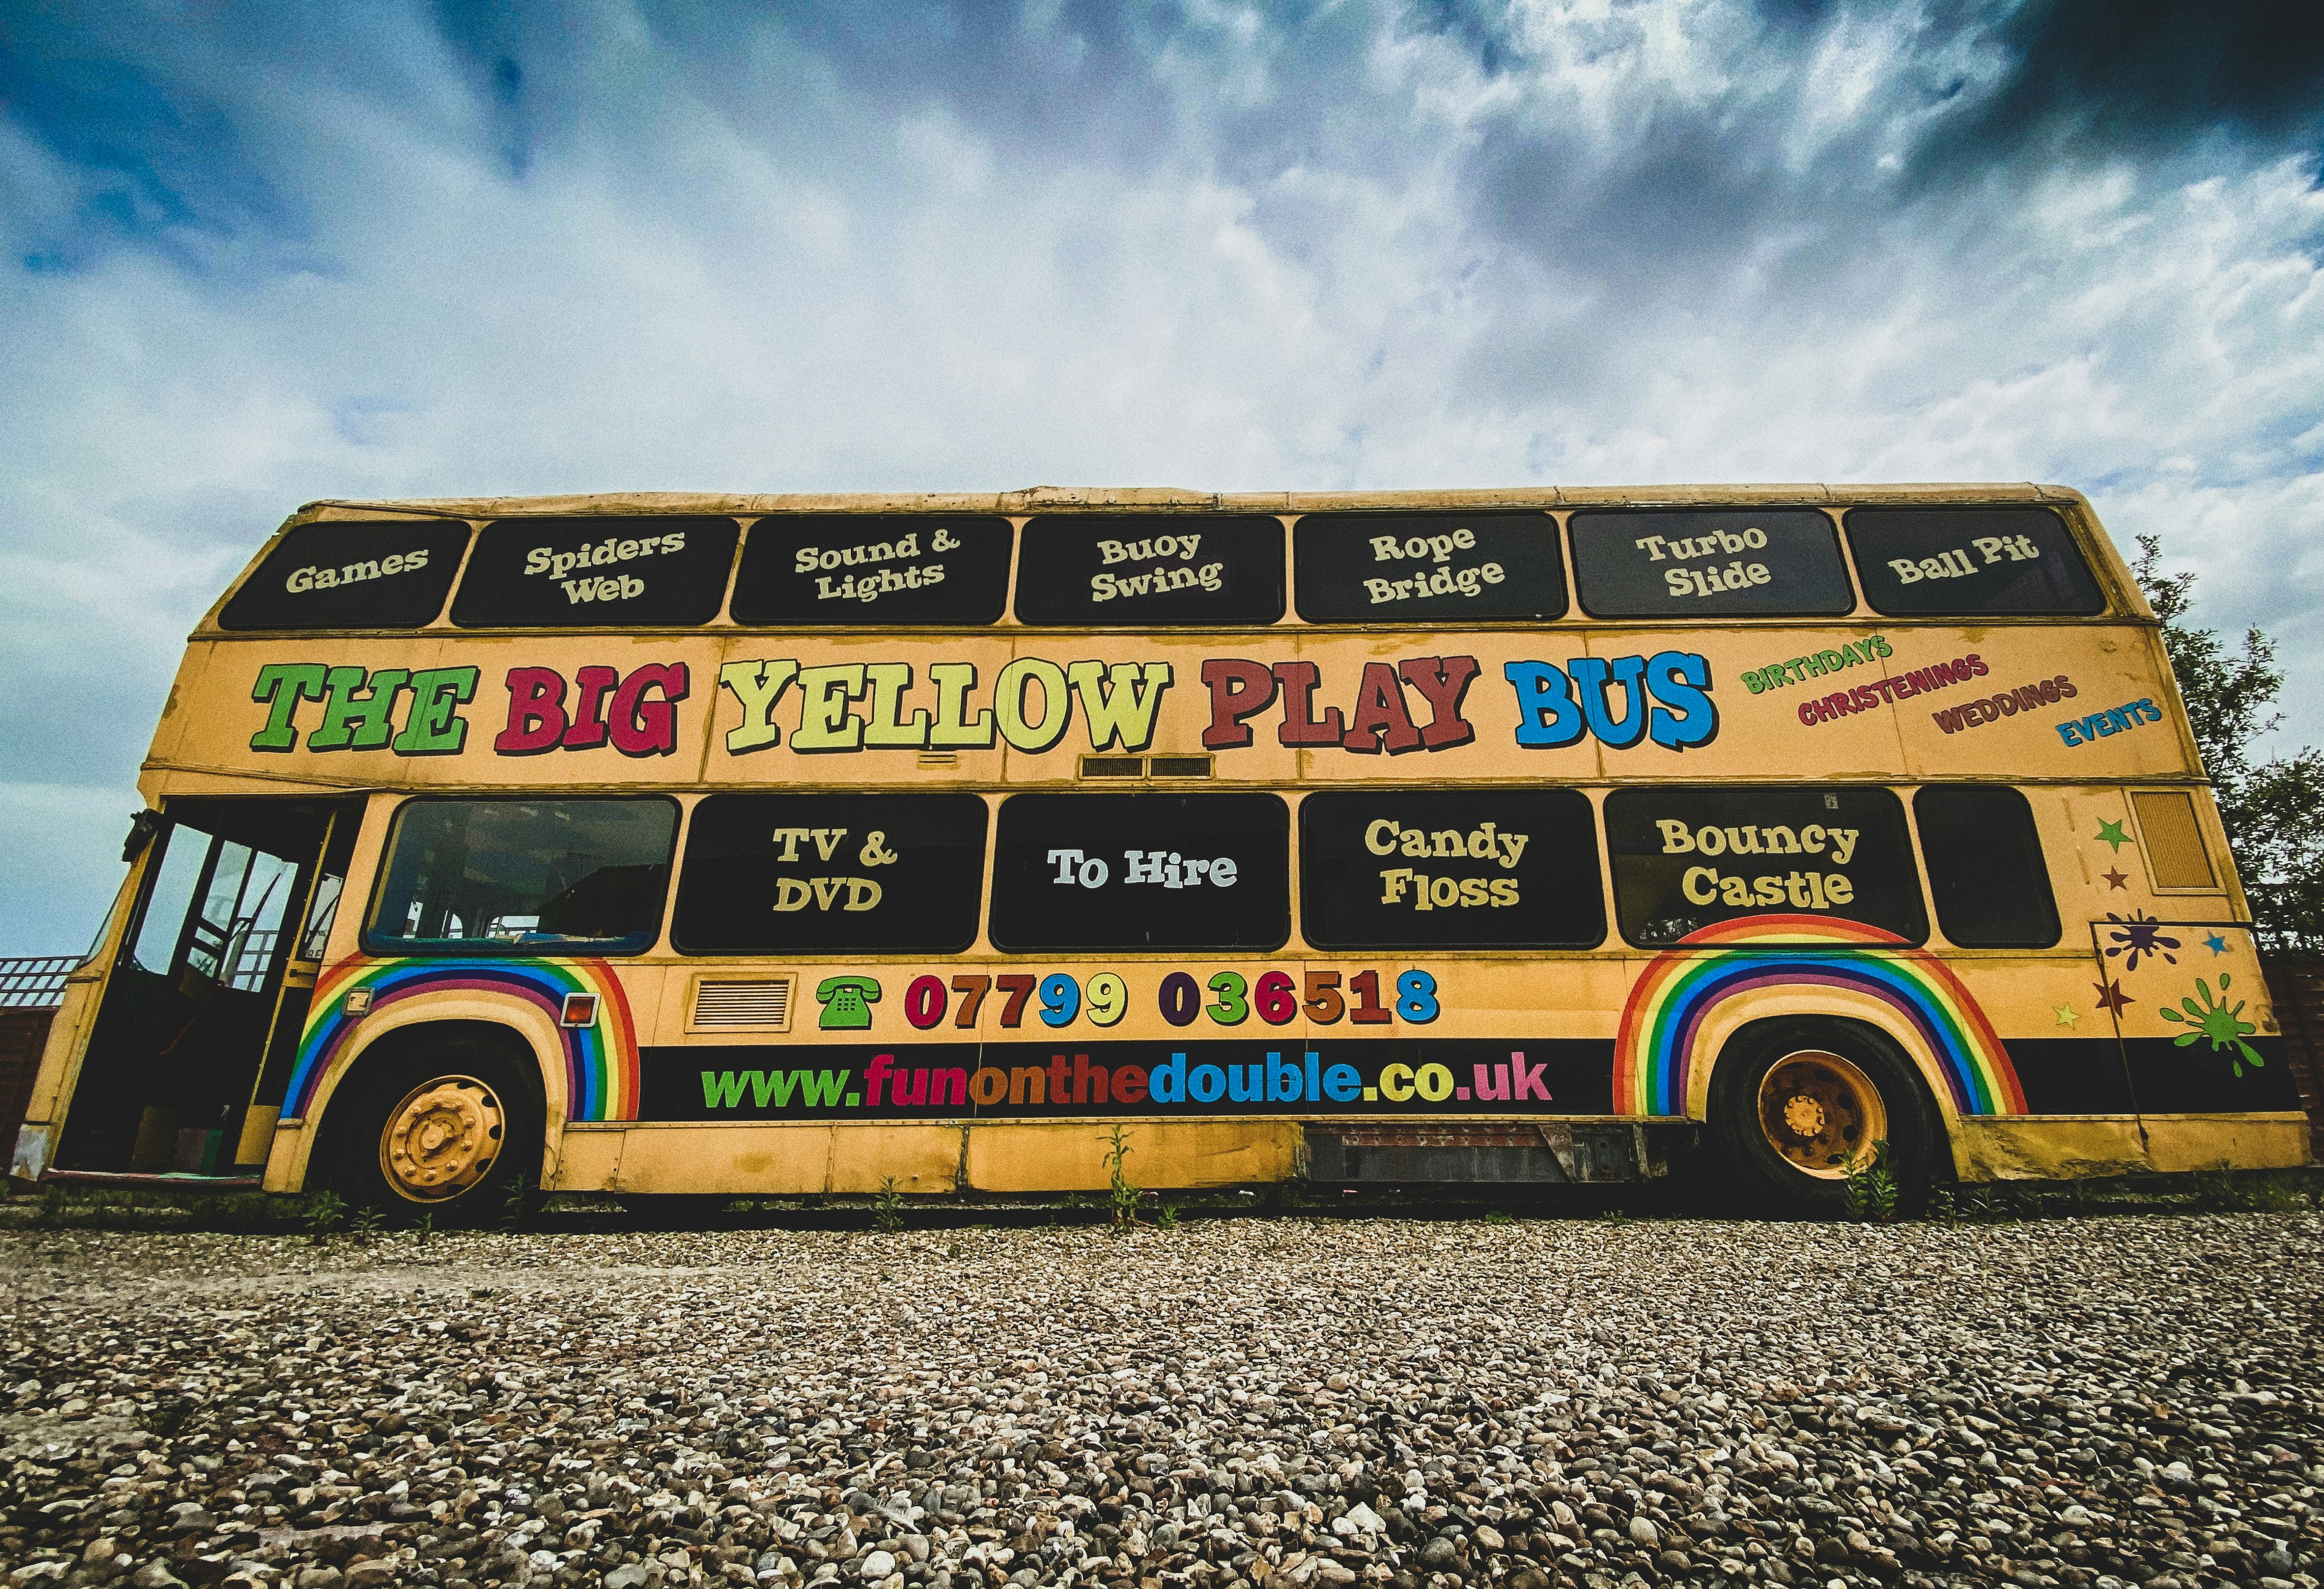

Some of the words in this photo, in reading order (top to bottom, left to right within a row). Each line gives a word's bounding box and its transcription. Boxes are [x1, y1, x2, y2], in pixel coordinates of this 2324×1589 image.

[524, 531, 686, 581] Spiders
[795, 531, 921, 573] Sound
[932, 528, 961, 551] &
[1097, 533, 1202, 565] Buoy
[1369, 528, 1476, 563] Rope
[1635, 526, 1768, 561] Turbo
[1888, 549, 1979, 585] Ball
[1971, 534, 2040, 564] Pit
[286, 548, 429, 594] Games
[561, 576, 645, 606] Web
[815, 563, 946, 603] Lights
[1090, 560, 1224, 602] Swing
[1363, 560, 1506, 604] Bridge
[1664, 560, 1772, 597] Slide
[1740, 635, 1893, 695] BIRTHDAYS
[250, 663, 482, 757] THE
[494, 662, 691, 758] BIG
[720, 657, 1175, 754] YELLOW
[1201, 655, 1481, 756] PLAY
[1503, 650, 1720, 753] BUS
[1797, 653, 1990, 727] CHRISTENINGS
[1931, 675, 2078, 735] WEDDINGS
[2055, 697, 2163, 748] EVENTS
[773, 827, 847, 862] TV
[859, 830, 898, 867] &
[1364, 819, 1529, 869] Candy
[1655, 819, 1859, 864] Bouncy
[1047, 849, 1108, 889] To
[1124, 849, 1238, 889] Hire
[1379, 867, 1520, 912] Floss
[1681, 867, 1855, 910] Castle
[772, 877, 882, 912] DVD
[904, 972, 1128, 1029] 07799
[1158, 969, 1441, 1027] 036518
[700, 1050, 1553, 1108] www.funonthedouble.co.uk
